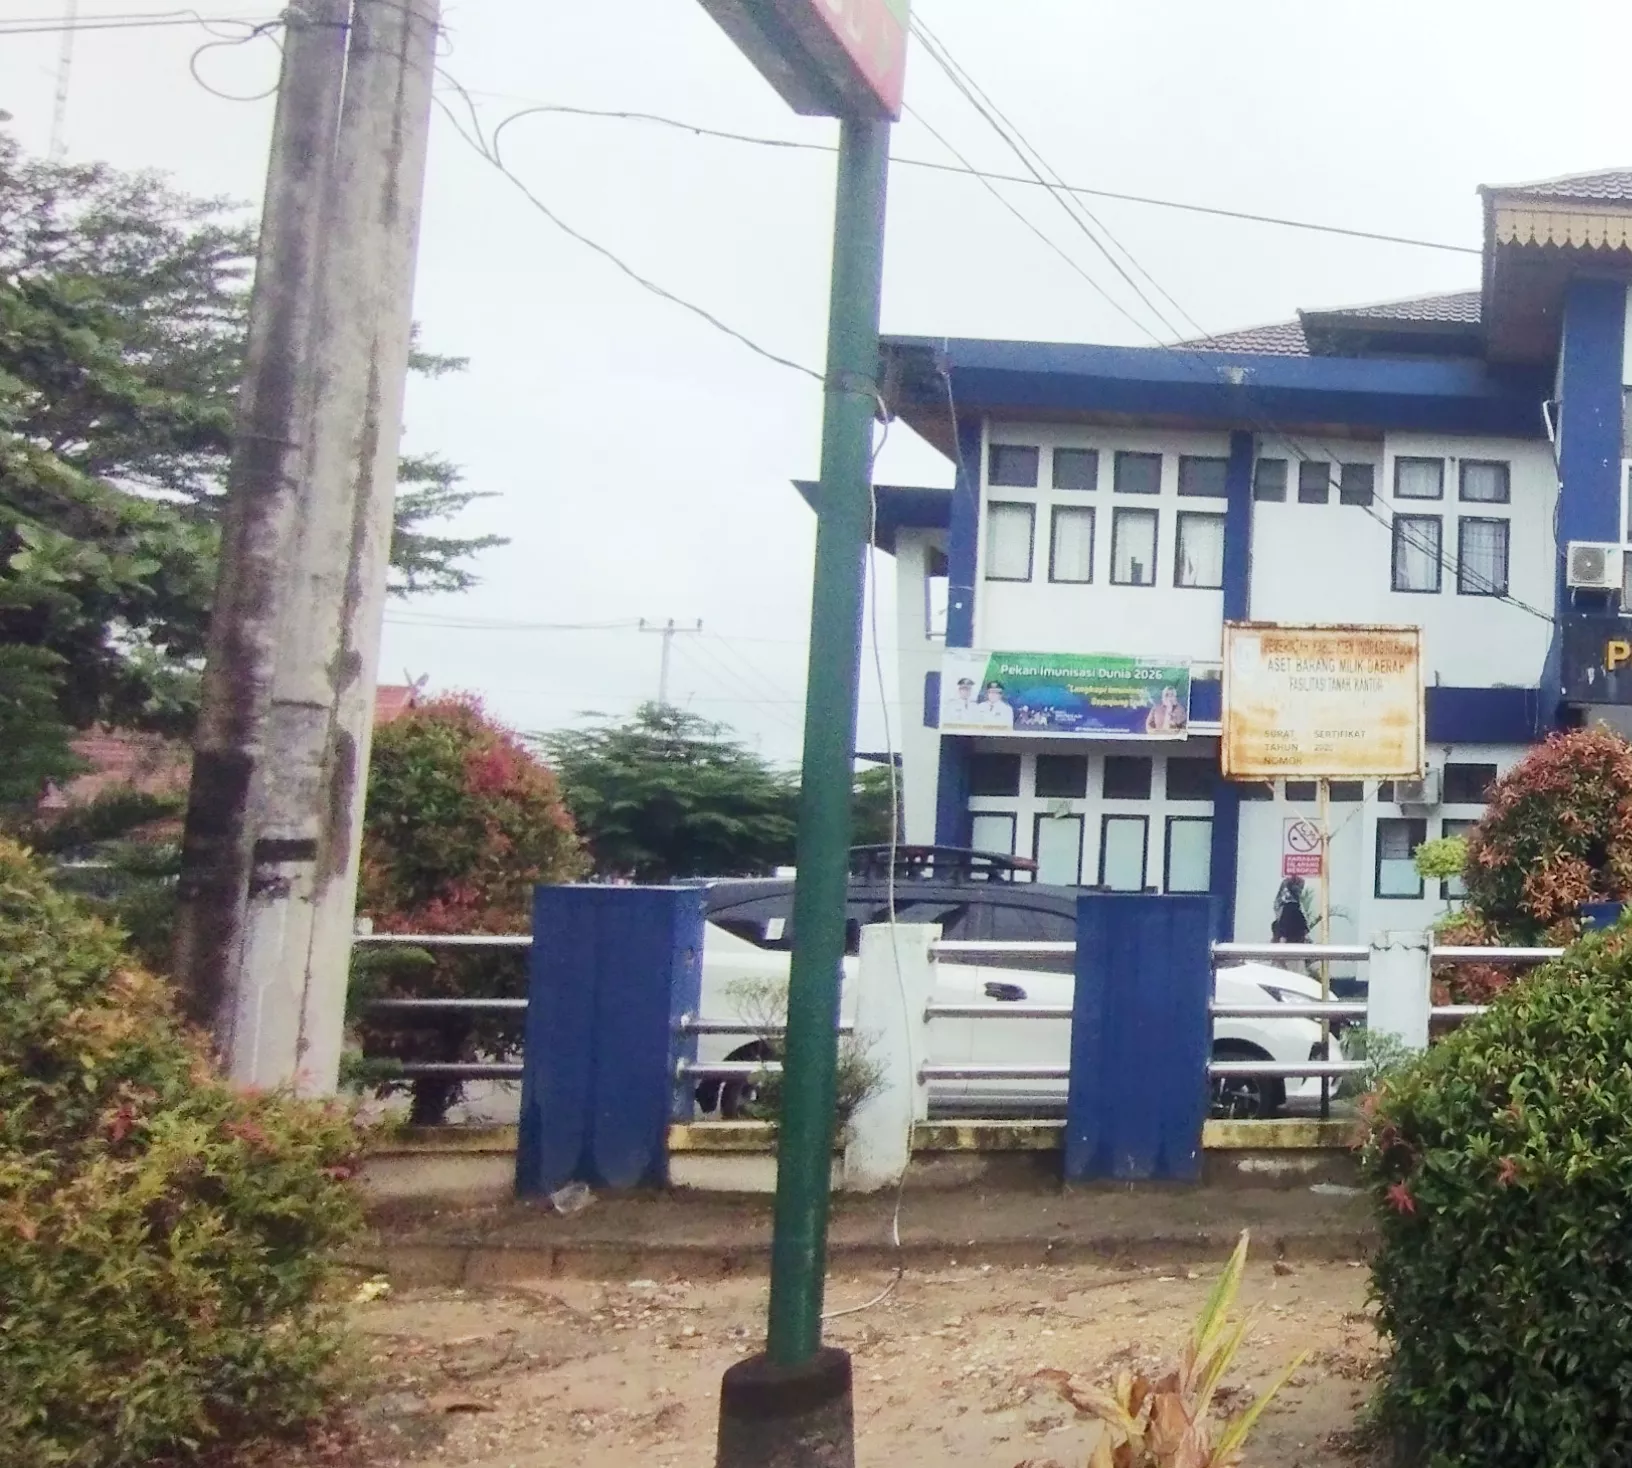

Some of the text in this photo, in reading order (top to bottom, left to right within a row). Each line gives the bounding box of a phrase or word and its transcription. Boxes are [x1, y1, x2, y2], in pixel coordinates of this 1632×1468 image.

[1268, 657, 1405, 674] ASET BARANG MILIK DAERAH
[1001, 664, 1037, 675] Pekan
[1040, 665, 1096, 678] Imunisasi
[1099, 668, 1131, 679] Dunia
[1264, 729, 1366, 739] SURAT SERTIFIKAT
[1264, 743, 1299, 752] TAHUN
[1263, 756, 1302, 766] NOMOR
